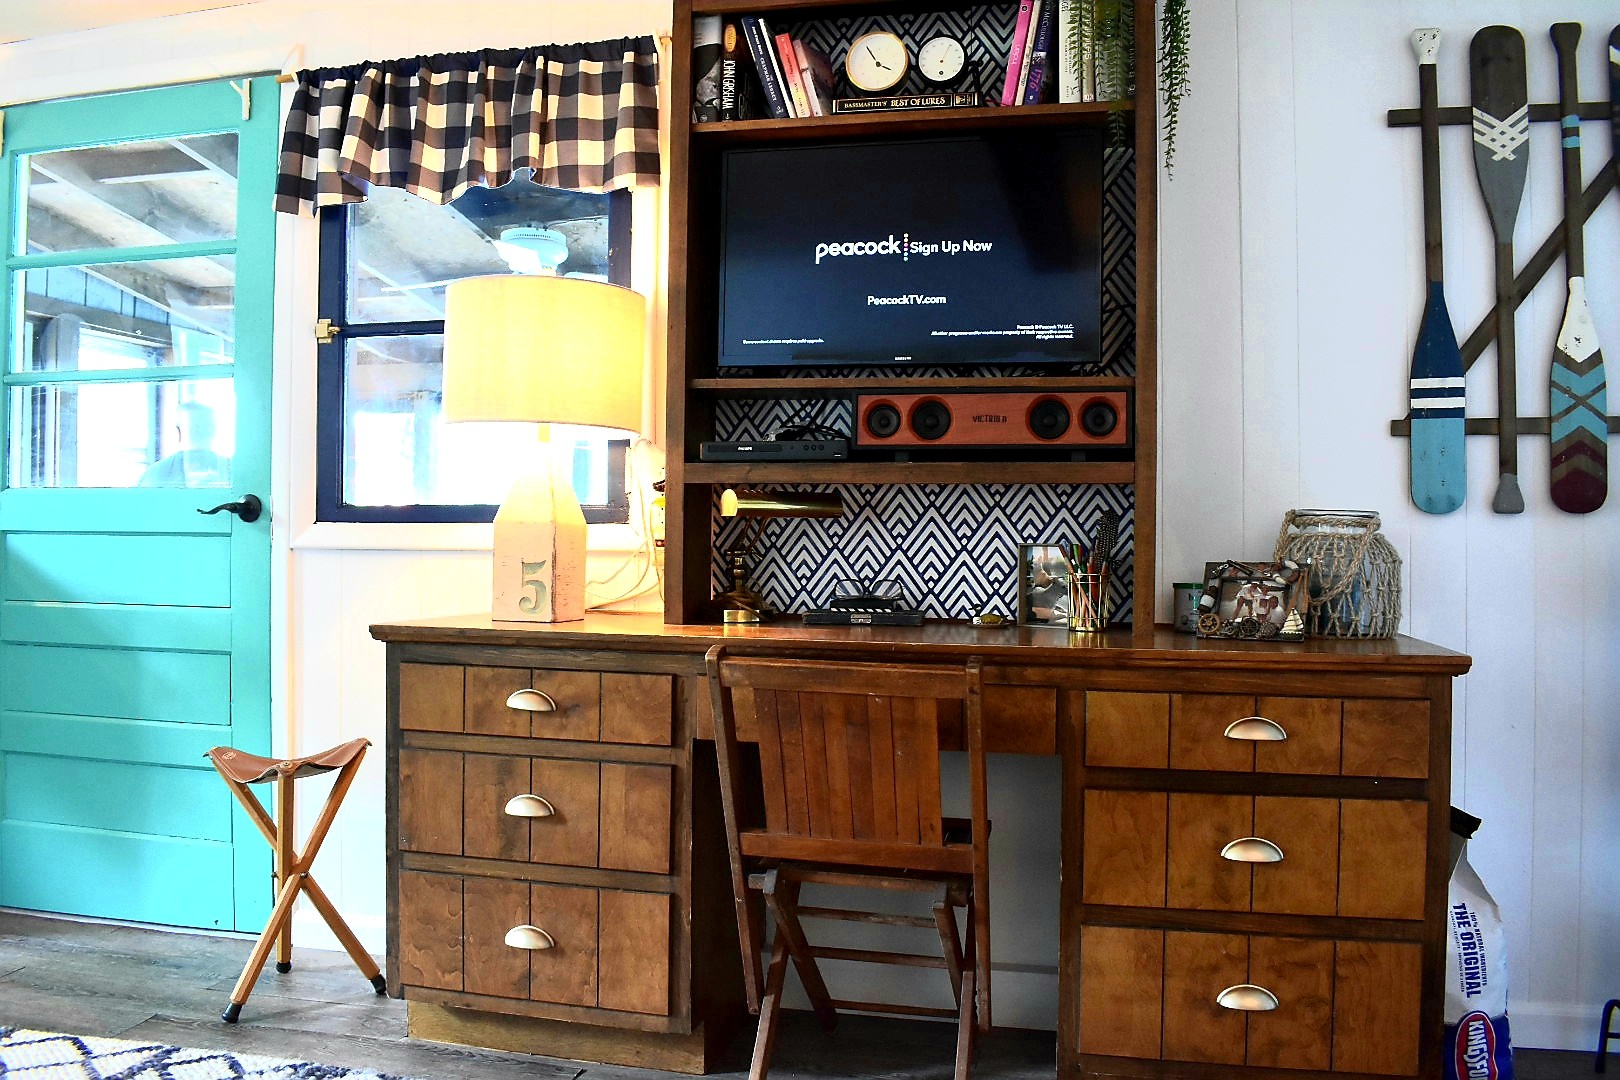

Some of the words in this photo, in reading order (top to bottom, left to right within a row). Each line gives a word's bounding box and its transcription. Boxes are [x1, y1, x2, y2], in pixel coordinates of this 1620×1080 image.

[723, 59, 735, 78] JOHN
[1029, 68, 1042, 92] 1776
[722, 78, 735, 110] GRISHAM
[844, 100, 888, 109] BASSMASTER'S
[890, 98, 908, 107] BEST
[910, 98, 921, 106] OF
[921, 97, 946, 106] LURES
[815, 235, 901, 264] peacock
[910, 241, 939, 256] Sign
[942, 241, 960, 255] Up
[962, 239, 993, 251] Now
[867, 294, 947, 305] PeacockTV.com
[519, 559, 547, 615] 5
[1452, 902, 1472, 929] THE
[1460, 929, 1482, 998] ORIGINAL
